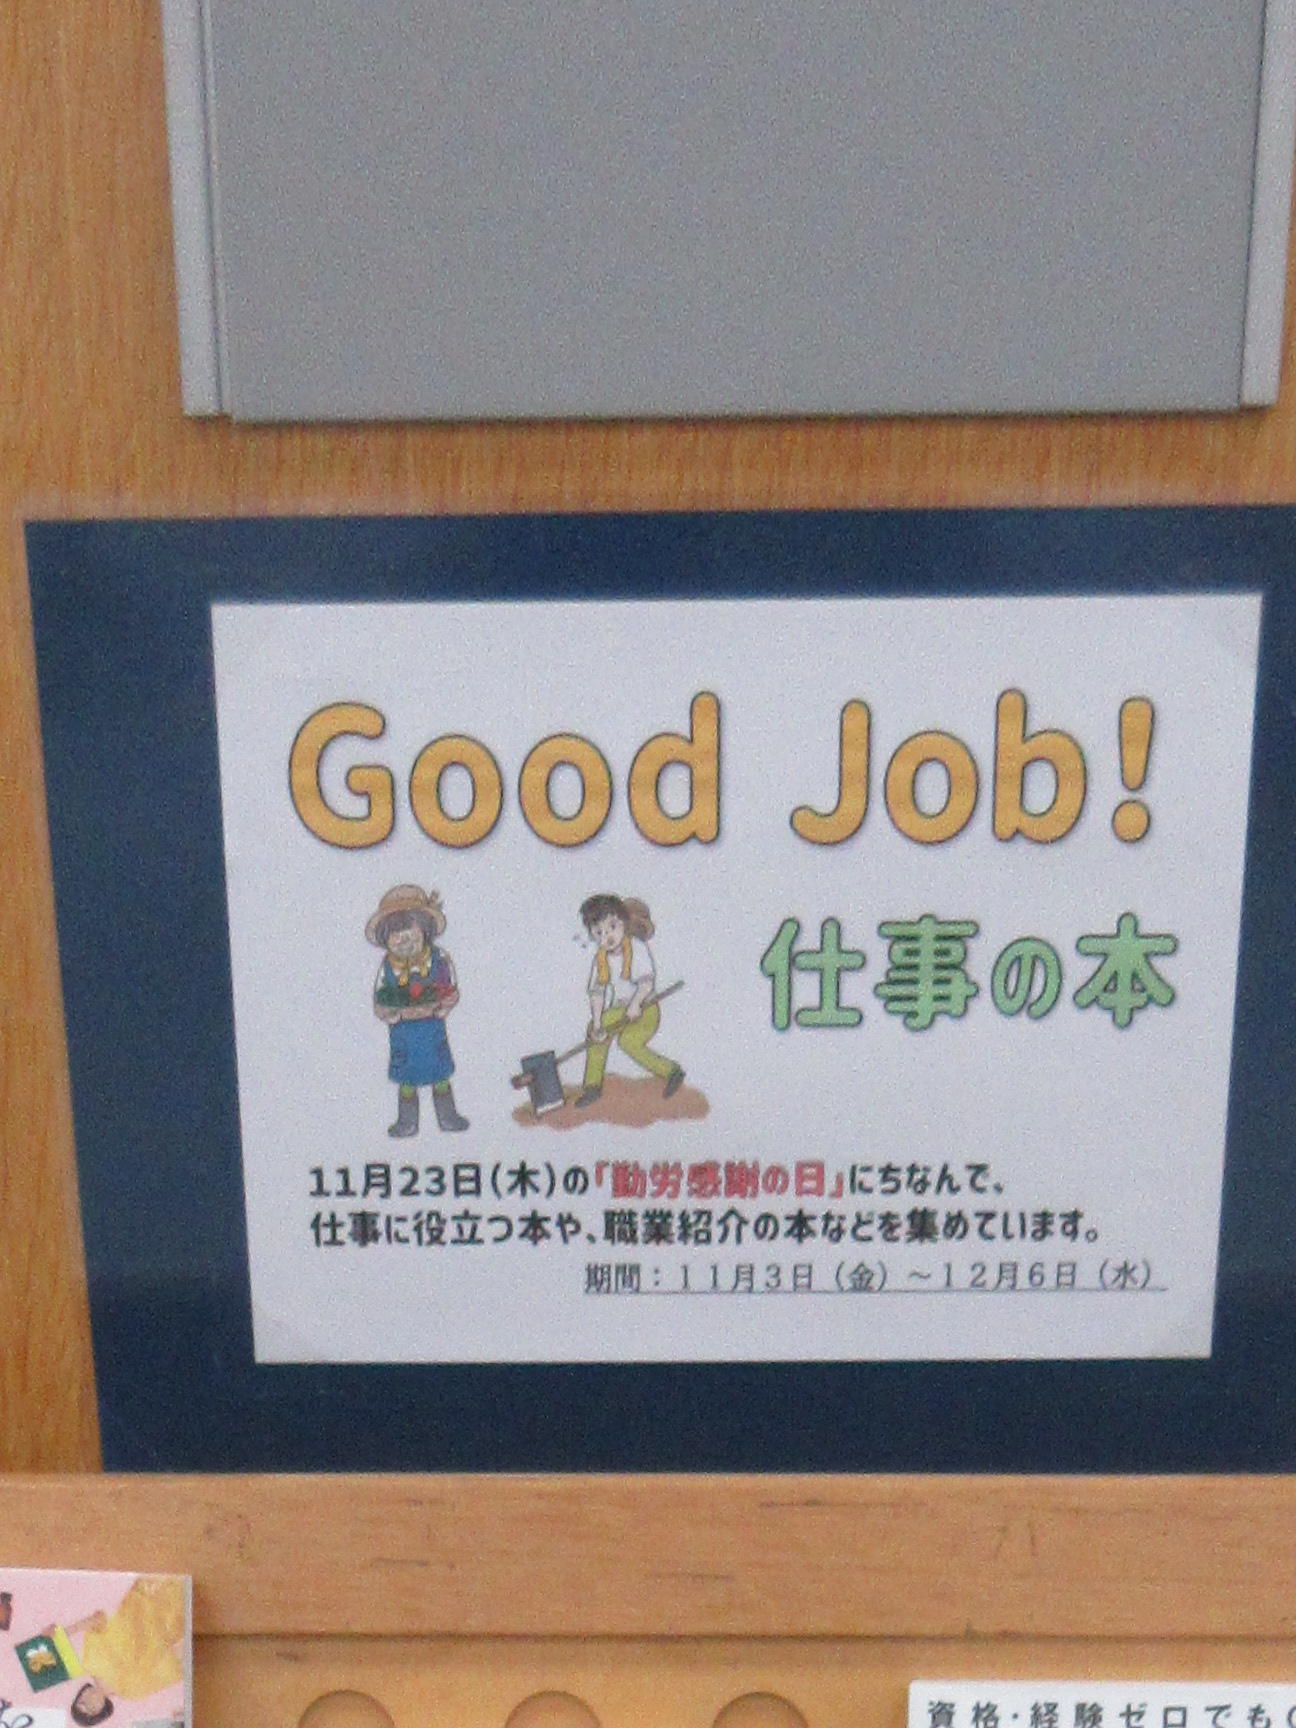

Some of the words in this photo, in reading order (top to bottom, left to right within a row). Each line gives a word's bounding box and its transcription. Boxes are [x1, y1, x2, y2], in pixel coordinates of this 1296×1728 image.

[287, 691, 721, 847] Good
[790, 689, 1158, 845] Job!
[761, 913, 1179, 1031] 仕事の本
[308, 1159, 1008, 1199] 11月23日(木)の「勤労感謝の日」にちなんで、
[311, 1207, 1101, 1249] 仕事に役立つ本や、職業紹介の本などを集めています。
